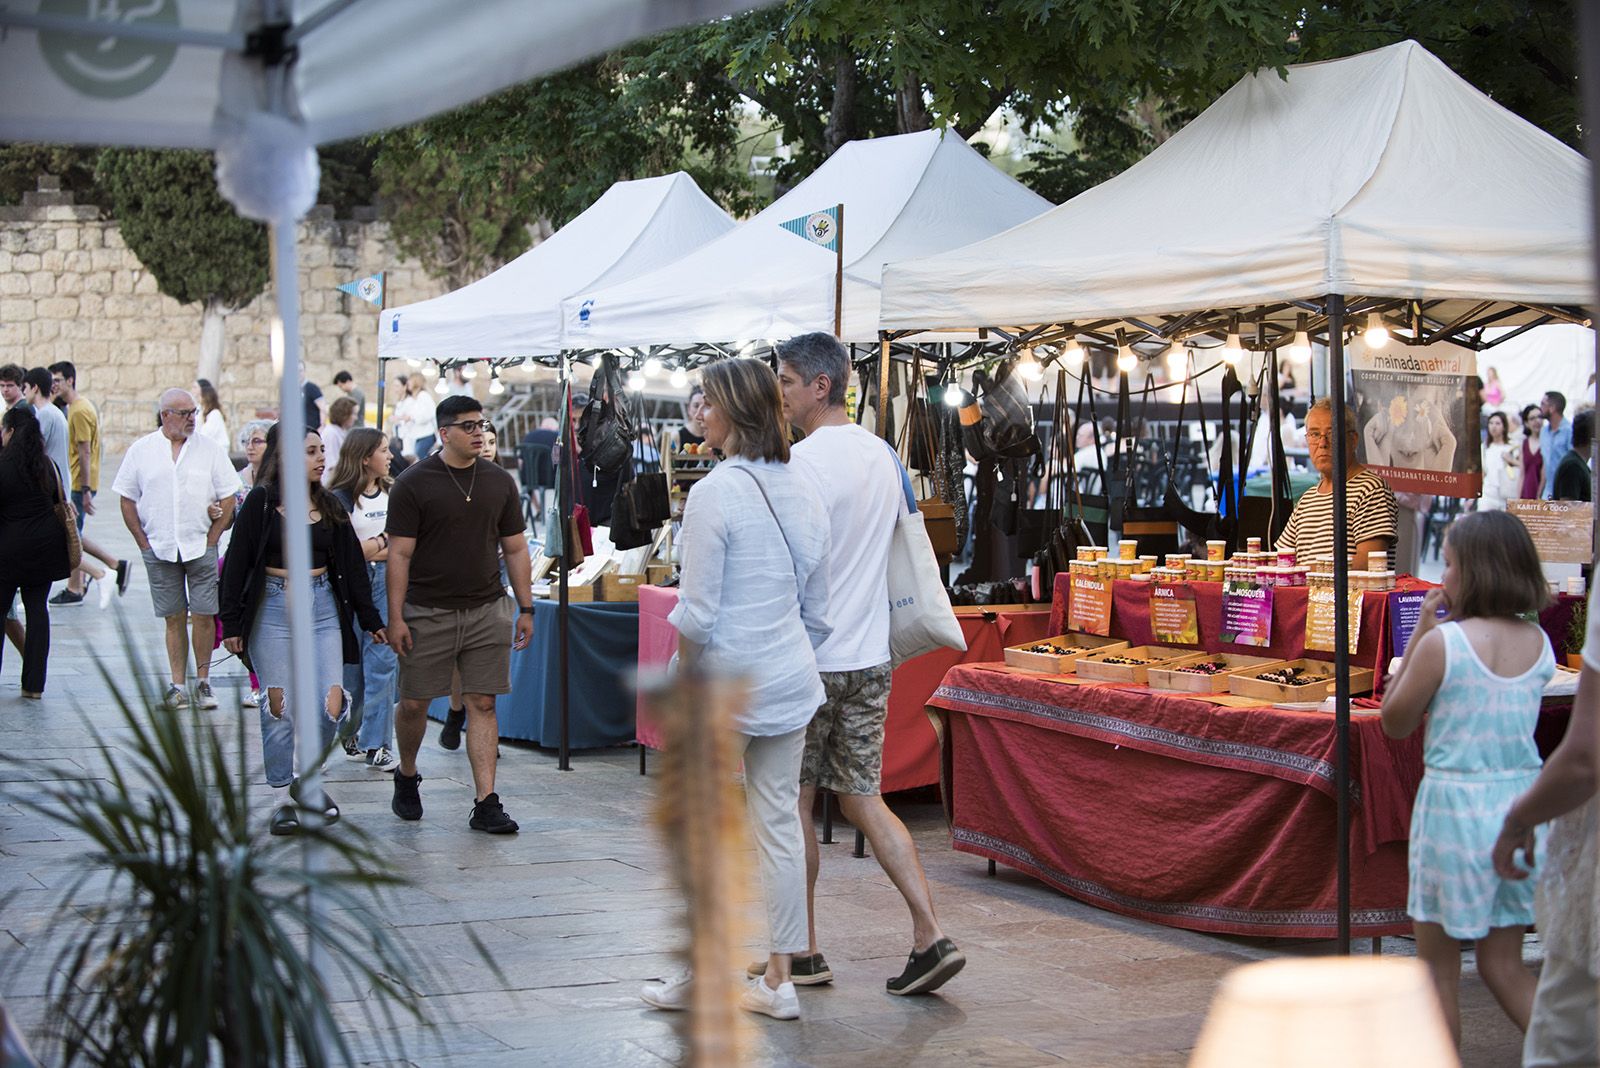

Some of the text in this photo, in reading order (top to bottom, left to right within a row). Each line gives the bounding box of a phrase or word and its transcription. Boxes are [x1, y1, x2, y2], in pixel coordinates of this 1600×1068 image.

[1374, 354, 1461, 373] mainadanatural
[1549, 504, 1569, 512] COCO
[1398, 595, 1424, 603] LAVANDA
